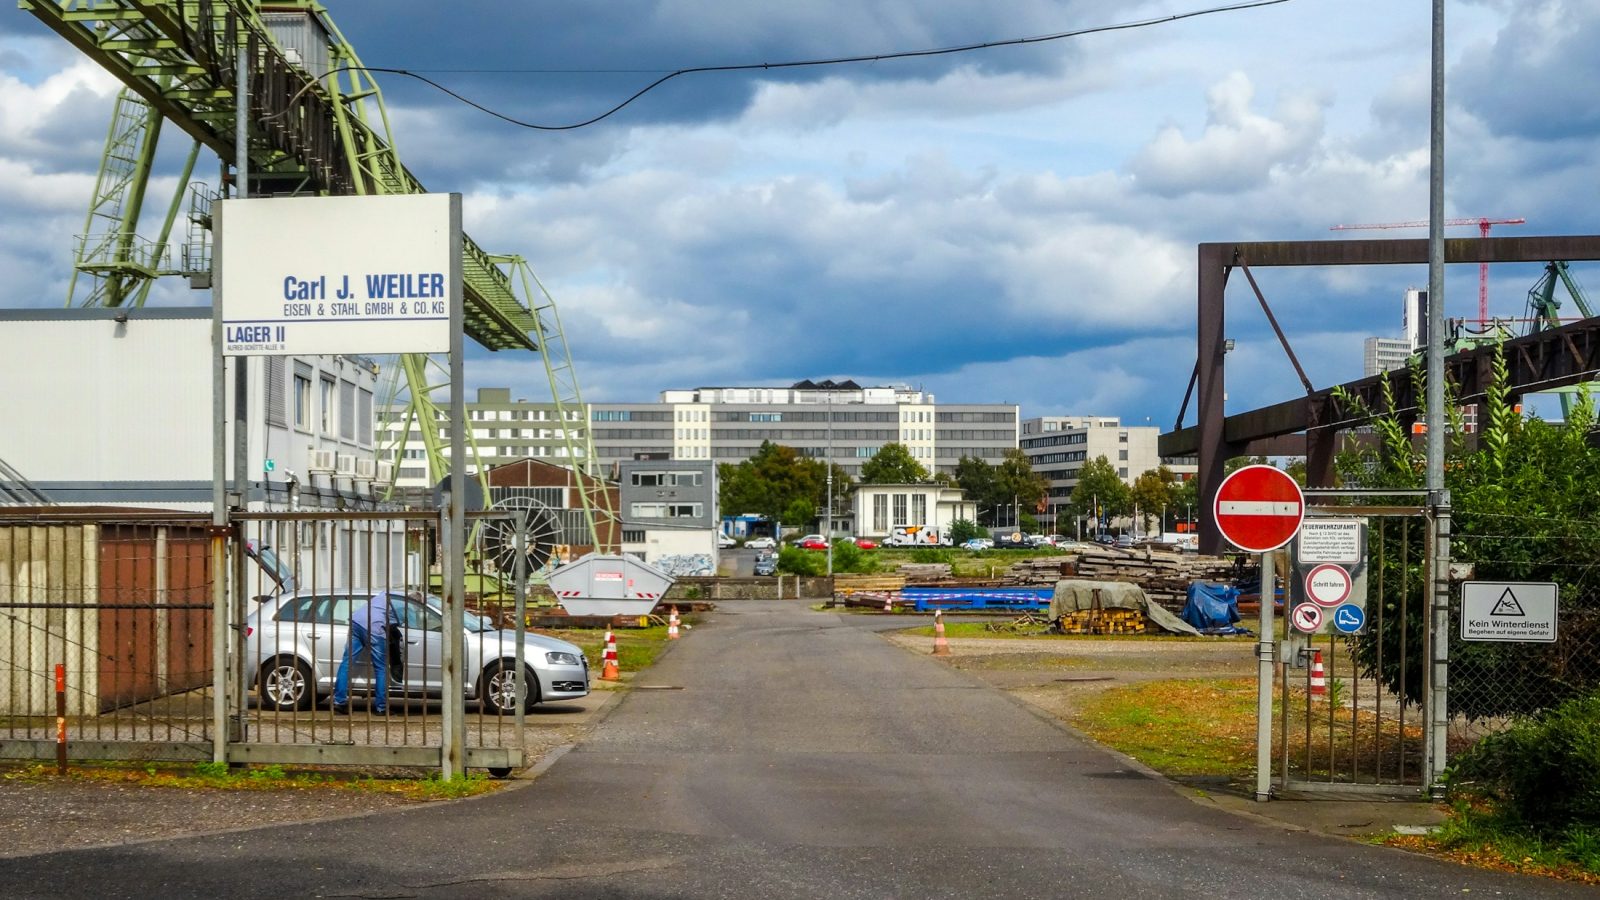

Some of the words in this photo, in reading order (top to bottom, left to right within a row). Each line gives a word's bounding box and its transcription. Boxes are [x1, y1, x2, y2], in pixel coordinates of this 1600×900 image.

[284, 275, 326, 301] Carl
[336, 275, 355, 300] J.
[366, 273, 445, 299] WEILER
[283, 303, 312, 317] EISEN
[317, 303, 325, 316] &
[331, 302, 361, 316] STAHL
[365, 302, 394, 315] GMBH
[400, 302, 408, 315] &
[413, 301, 429, 315] CO.
[432, 301, 445, 314] KG
[227, 326, 271, 343] LAGER
[276, 326, 285, 342] II
[1468, 620, 1489, 628] Kein
[1492, 620, 1550, 629] Winterdienst
